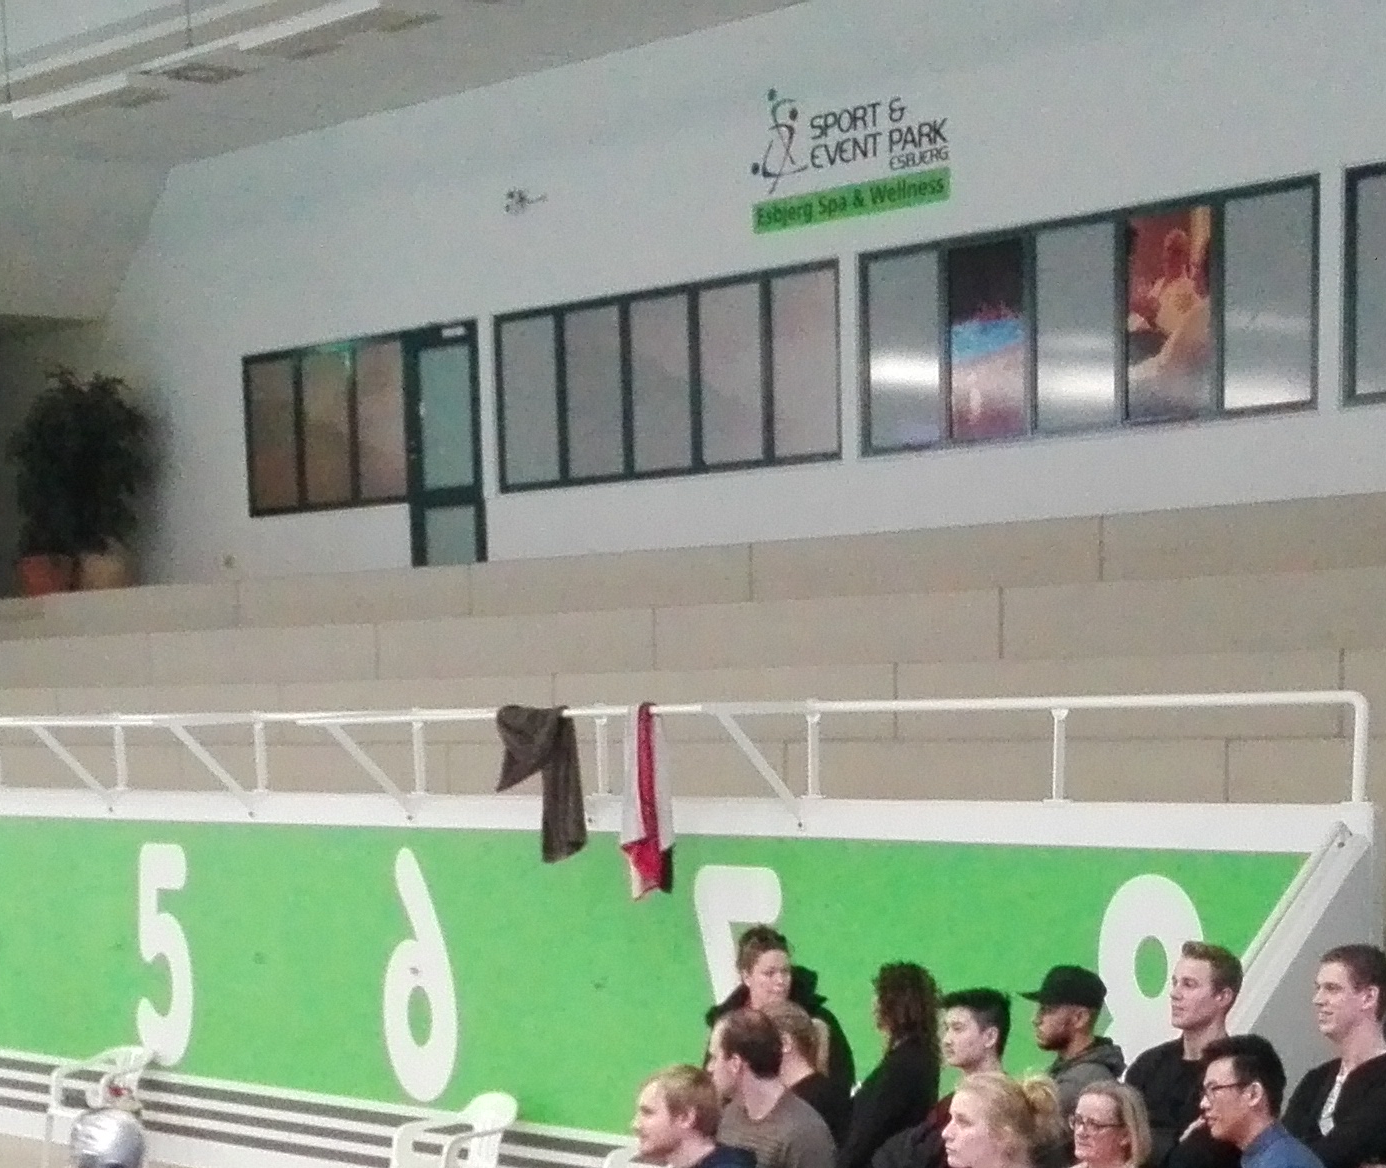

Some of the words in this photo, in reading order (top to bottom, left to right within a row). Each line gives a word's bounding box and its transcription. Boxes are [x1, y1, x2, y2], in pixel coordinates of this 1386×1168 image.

[810, 102, 881, 140] SPORT
[888, 97, 907, 123] &
[810, 132, 882, 169] EVENT
[888, 118, 948, 153] PARK
[889, 146, 949, 171] ESBJERG
[756, 201, 813, 227] Esbjerg
[818, 194, 847, 217] Spa
[852, 189, 865, 208] &
[869, 178, 944, 206] Wellness
[136, 842, 193, 1066] 5
